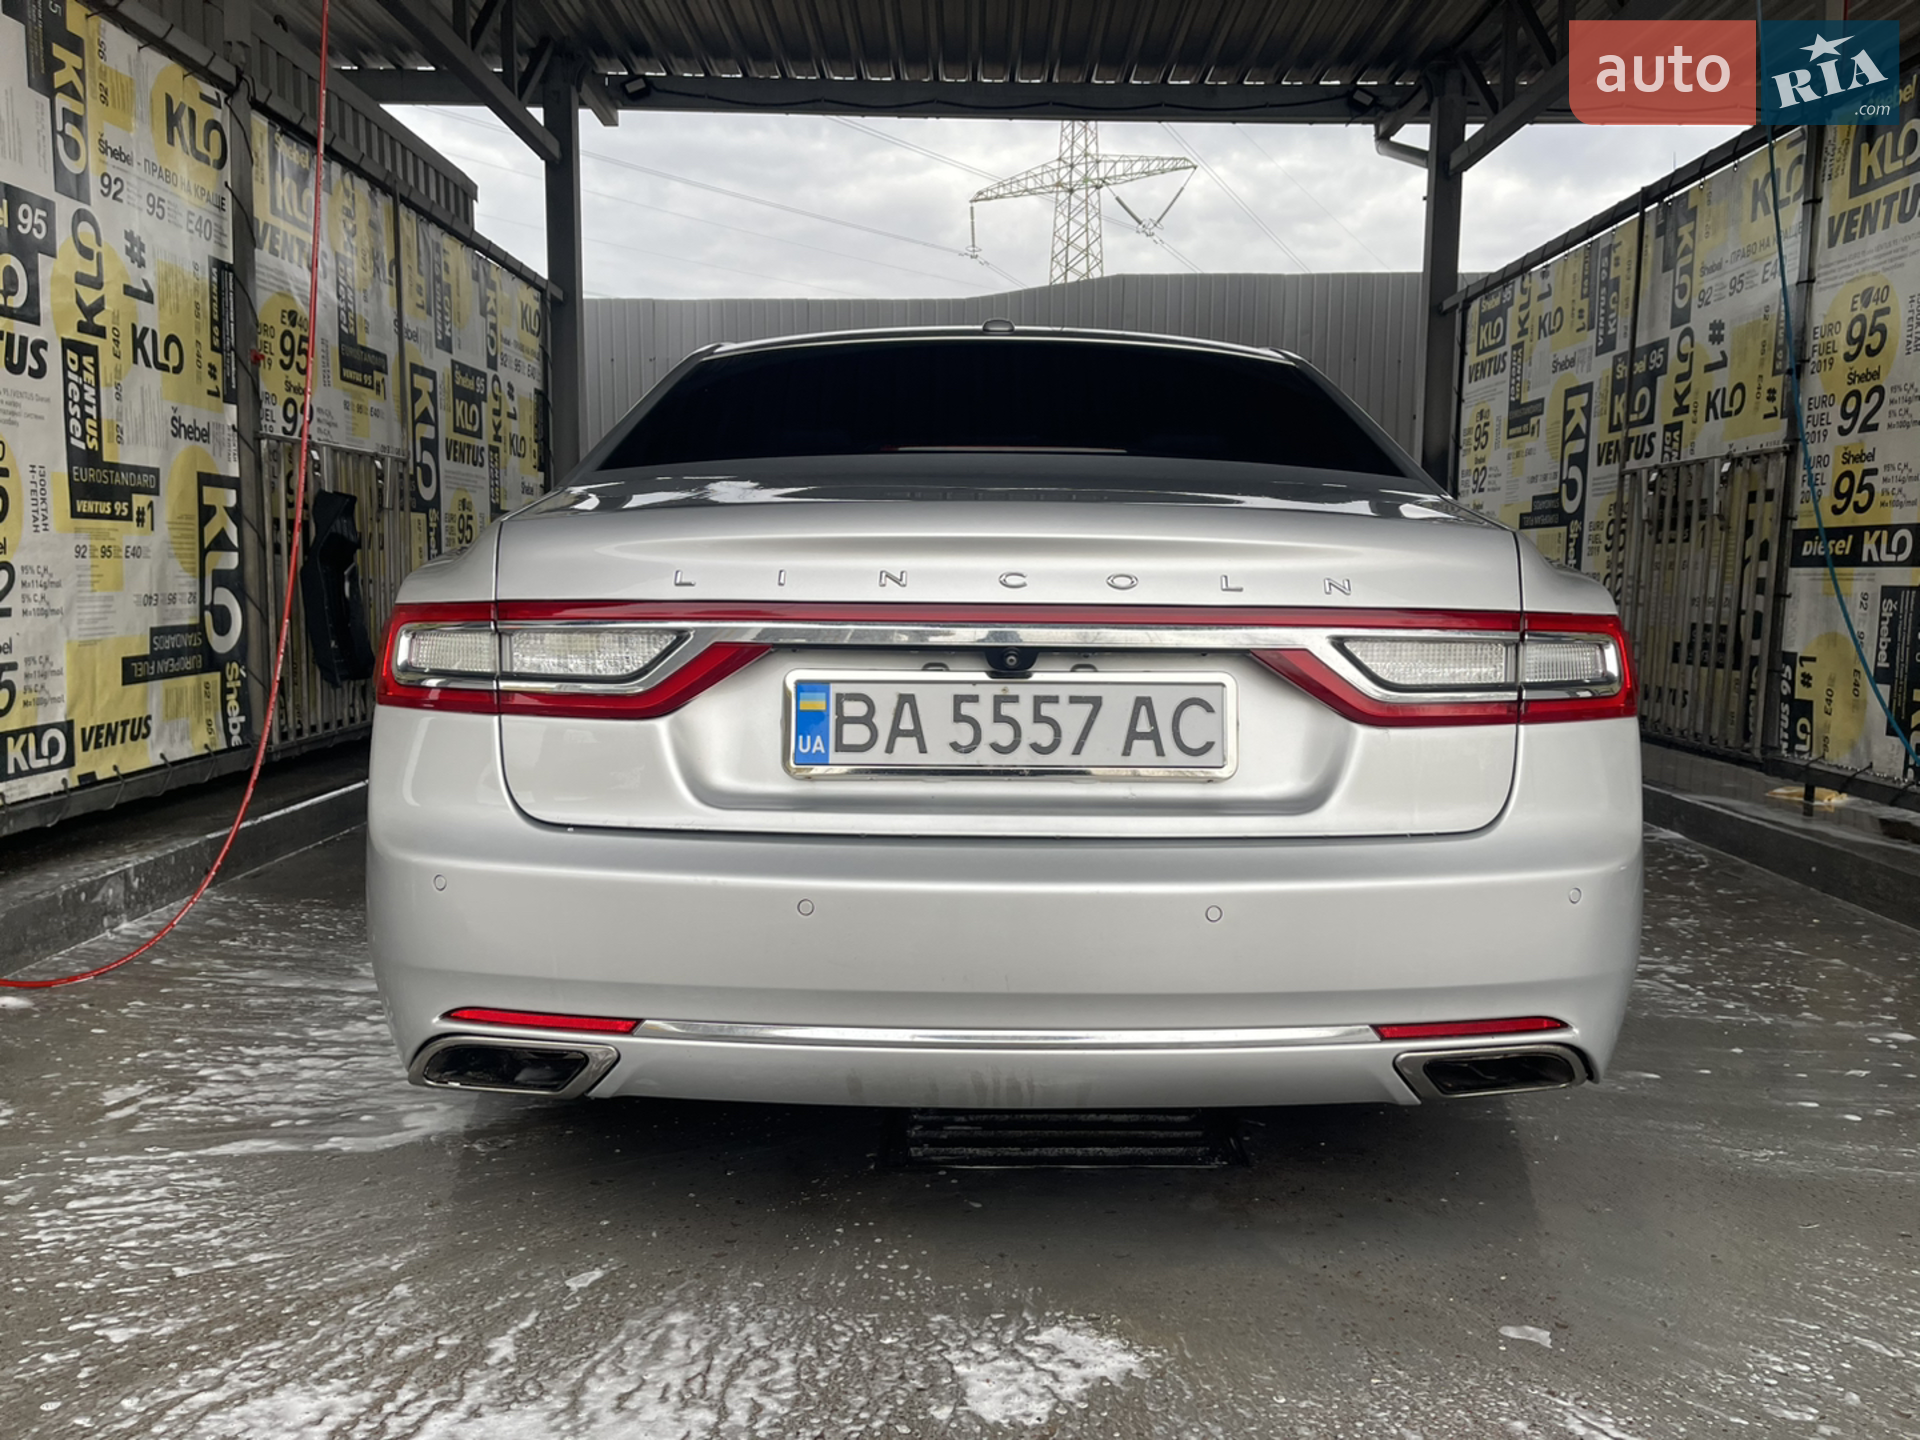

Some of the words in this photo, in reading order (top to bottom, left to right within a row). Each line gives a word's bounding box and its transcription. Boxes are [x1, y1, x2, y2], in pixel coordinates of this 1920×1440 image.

[52, 41, 88, 175] KLO
[164, 91, 229, 172] KLO
[1858, 118, 1920, 188] KLO
[143, 157, 179, 188] ПРАВО
[179, 175, 194, 194] НА
[194, 183, 227, 213] КРАЩЕ
[1750, 152, 1805, 224] KLO
[17, 203, 48, 240] 95
[99, 171, 125, 204] 92
[145, 193, 166, 221] 95
[186, 208, 214, 244] E40
[1827, 182, 1920, 250] VENTU
[1674, 221, 1695, 309] KLO
[1729, 241, 1758, 266] ПРАВО
[70, 206, 107, 340] KLO
[1697, 286, 1714, 309] 92
[1728, 273, 1746, 297] 95
[486, 287, 498, 357] KLO
[1537, 306, 1565, 341] KLO
[1607, 291, 1621, 336] KLO
[1812, 321, 1842, 341] EURO
[111, 326, 122, 360] E40
[131, 322, 185, 375] KLO
[1478, 316, 1505, 351] KLO
[1811, 340, 1838, 359] FUEL
[1843, 306, 1891, 363] 95
[1467, 350, 1508, 385] VENTUS
[1648, 347, 1665, 371] 95
[1671, 326, 1696, 418] KLO
[1809, 357, 1835, 375] 2019
[81, 355, 99, 452] VENTUS
[454, 398, 480, 433] KLO
[490, 373, 503, 444] KLO
[1704, 381, 1747, 424] KLO
[1807, 393, 1836, 412] EURO
[1837, 384, 1886, 437] 92
[413, 372, 438, 501] KLO
[1473, 420, 1491, 452] 95
[1804, 429, 1829, 445] 2019
[1805, 412, 1833, 429] FUEL
[445, 437, 486, 469] VENTUS
[508, 432, 527, 460] KLO
[1561, 392, 1589, 515] KLO
[72, 465, 157, 490] EUROSTANDARD
[1471, 465, 1488, 495] 92
[1830, 467, 1880, 516] 95
[76, 499, 112, 516] VENTUS
[113, 500, 130, 517] 95
[457, 513, 473, 546] 95
[1801, 534, 1854, 557] Diesel
[1860, 528, 1914, 564] KLO
[74, 544, 88, 560] 92
[100, 544, 113, 560] 95
[124, 545, 143, 560] E40
[201, 484, 243, 654] KLO
[187, 591, 198, 605] 92
[673, 568, 1353, 597] LINCOLN
[152, 632, 203, 651] STANDARDS
[156, 654, 203, 676] EUROPEAN
[1852, 668, 1862, 698] E40
[1824, 688, 1835, 717] E40
[80, 714, 152, 753] VENTUS
[833, 692, 928, 755] BA
[948, 693, 1104, 756] 5557
[1120, 696, 1217, 757] AC
[6, 726, 68, 776] KLO
[798, 733, 826, 755] UA
